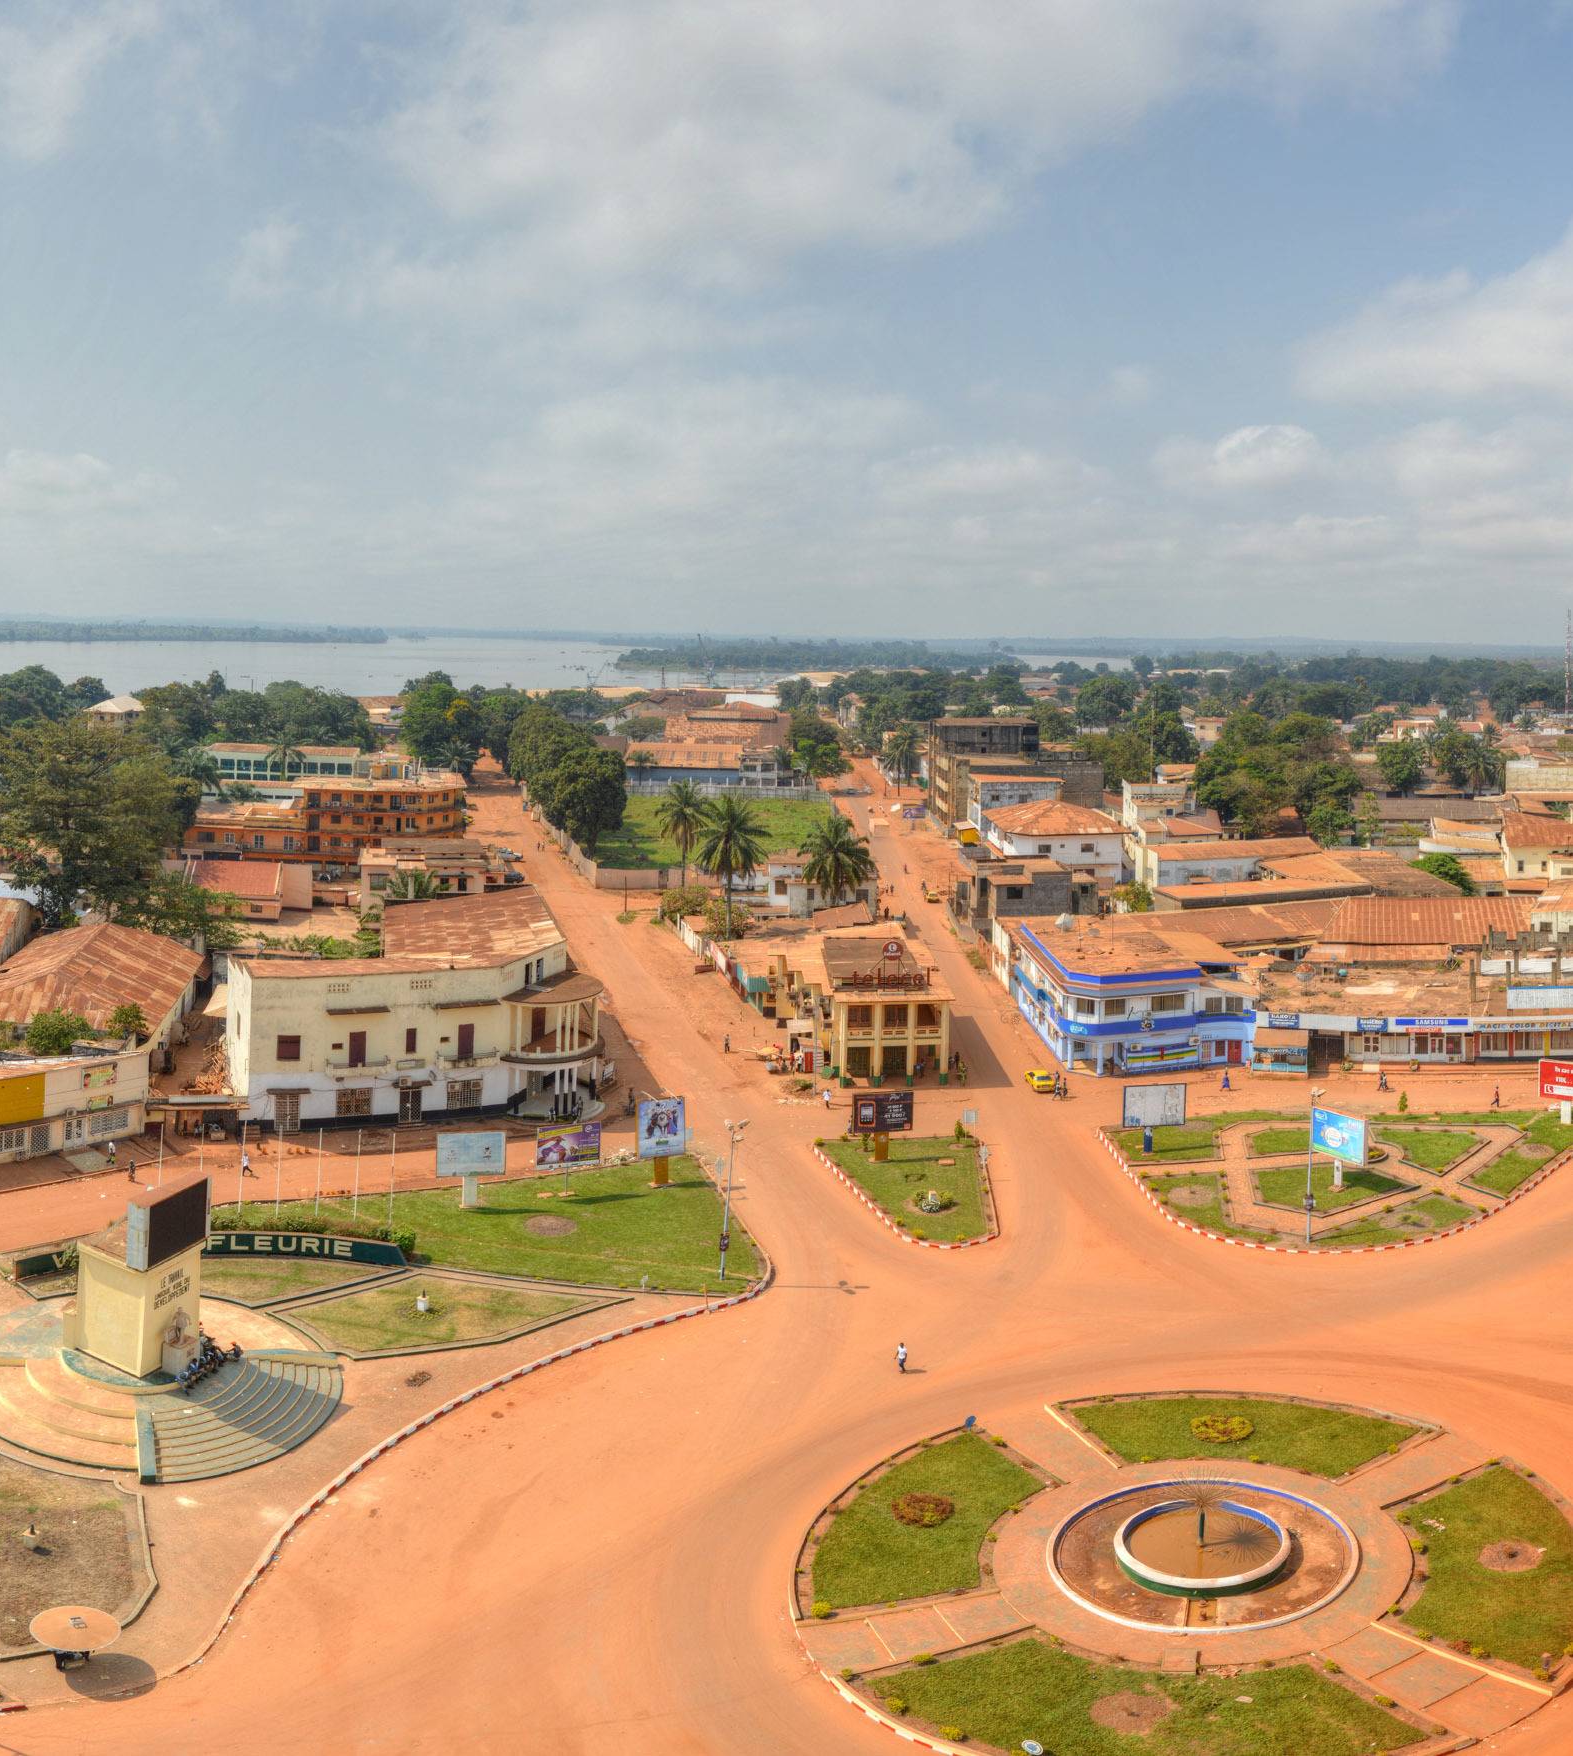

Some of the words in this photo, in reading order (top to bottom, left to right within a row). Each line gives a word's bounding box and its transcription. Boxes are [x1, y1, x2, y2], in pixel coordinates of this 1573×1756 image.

[852, 967, 933, 987] telecel
[207, 1235, 353, 1257] FLEURIE
[160, 1276, 167, 1289] LE
[168, 1268, 184, 1284] TRAVAIL
